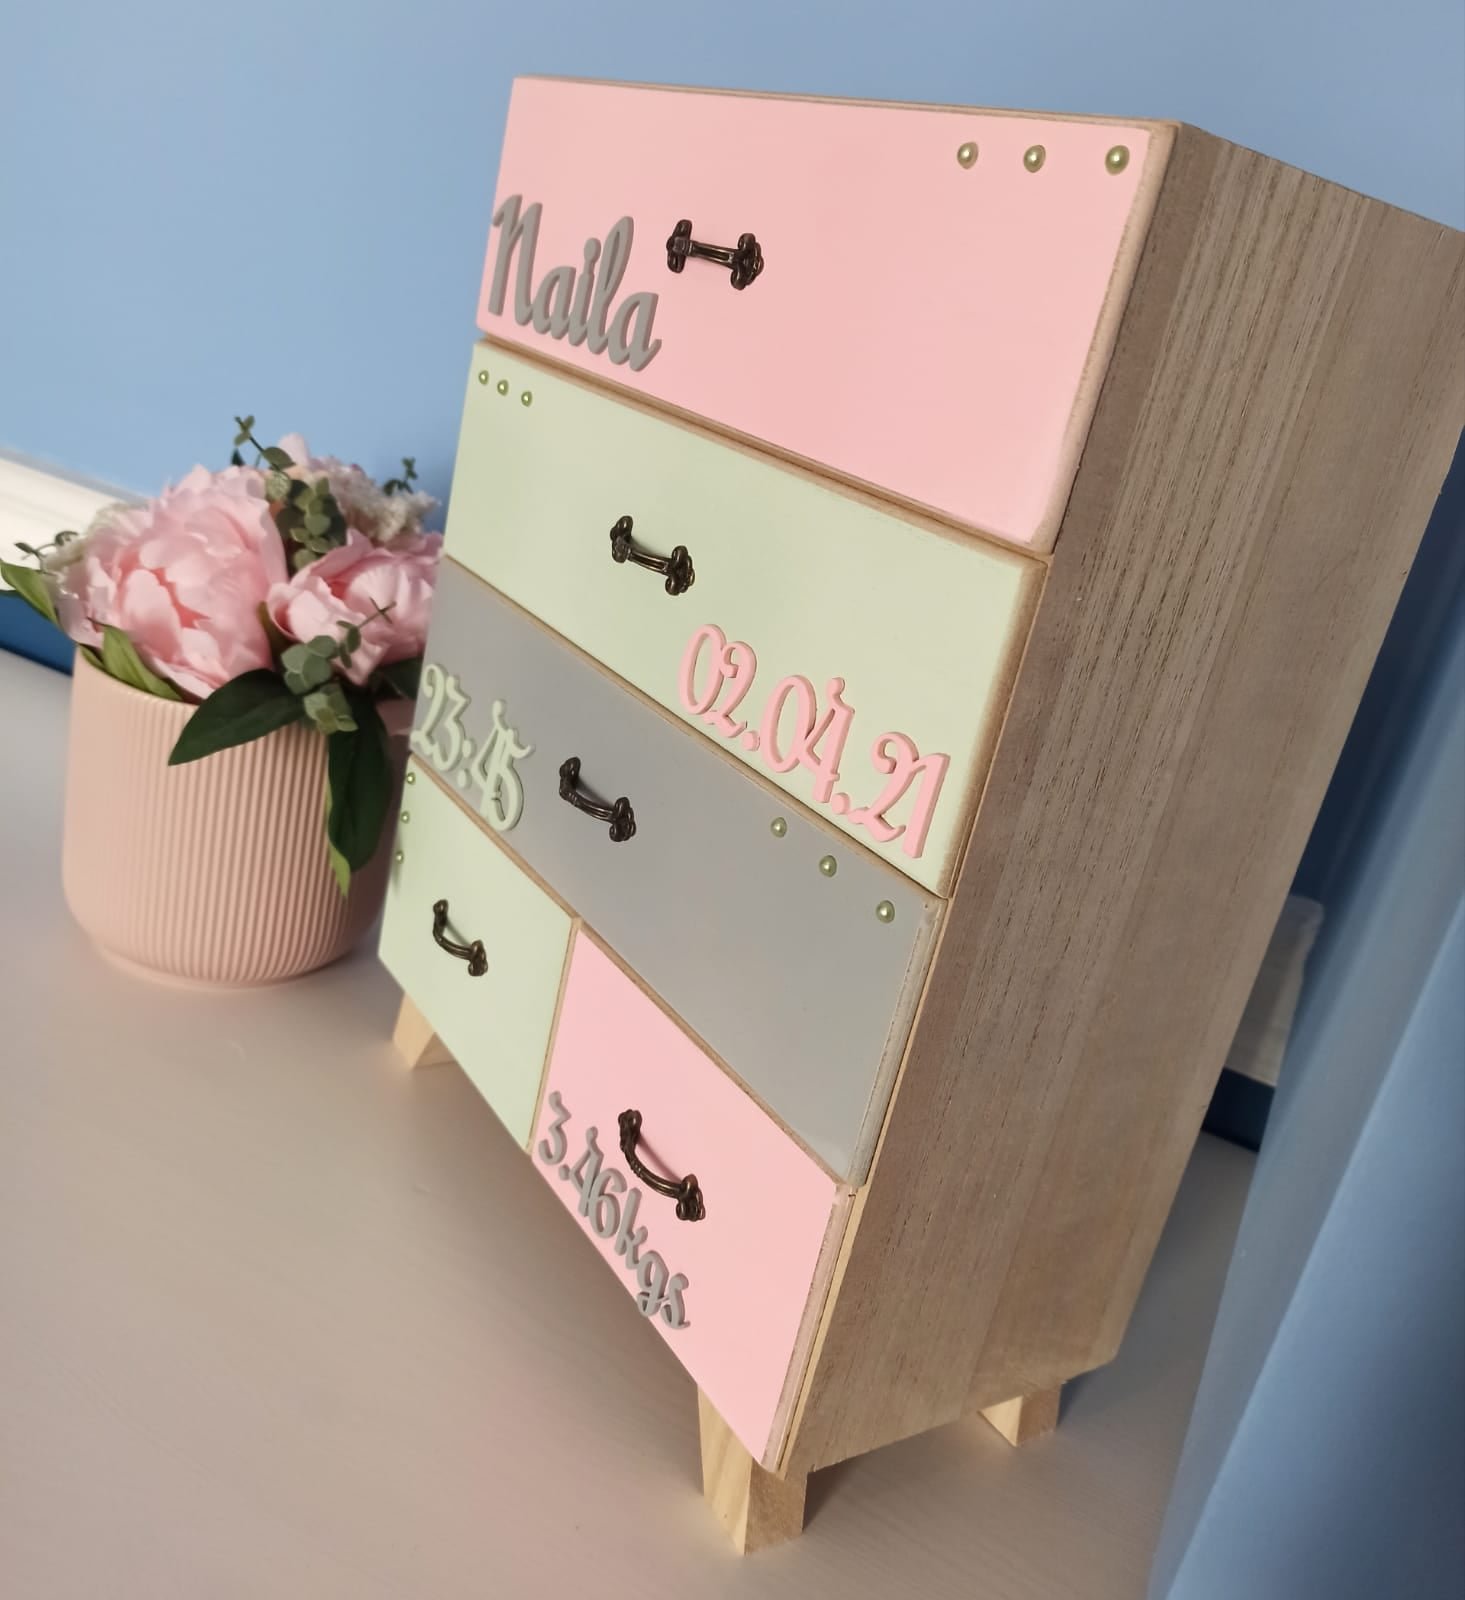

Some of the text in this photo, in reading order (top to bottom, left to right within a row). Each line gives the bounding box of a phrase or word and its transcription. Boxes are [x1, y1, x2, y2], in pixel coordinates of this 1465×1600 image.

[488, 194, 662, 372] Naila
[410, 664, 534, 831] 23:45
[679, 623, 951, 859] 02.04.21
[538, 1090, 691, 1330] 3.46kgs
